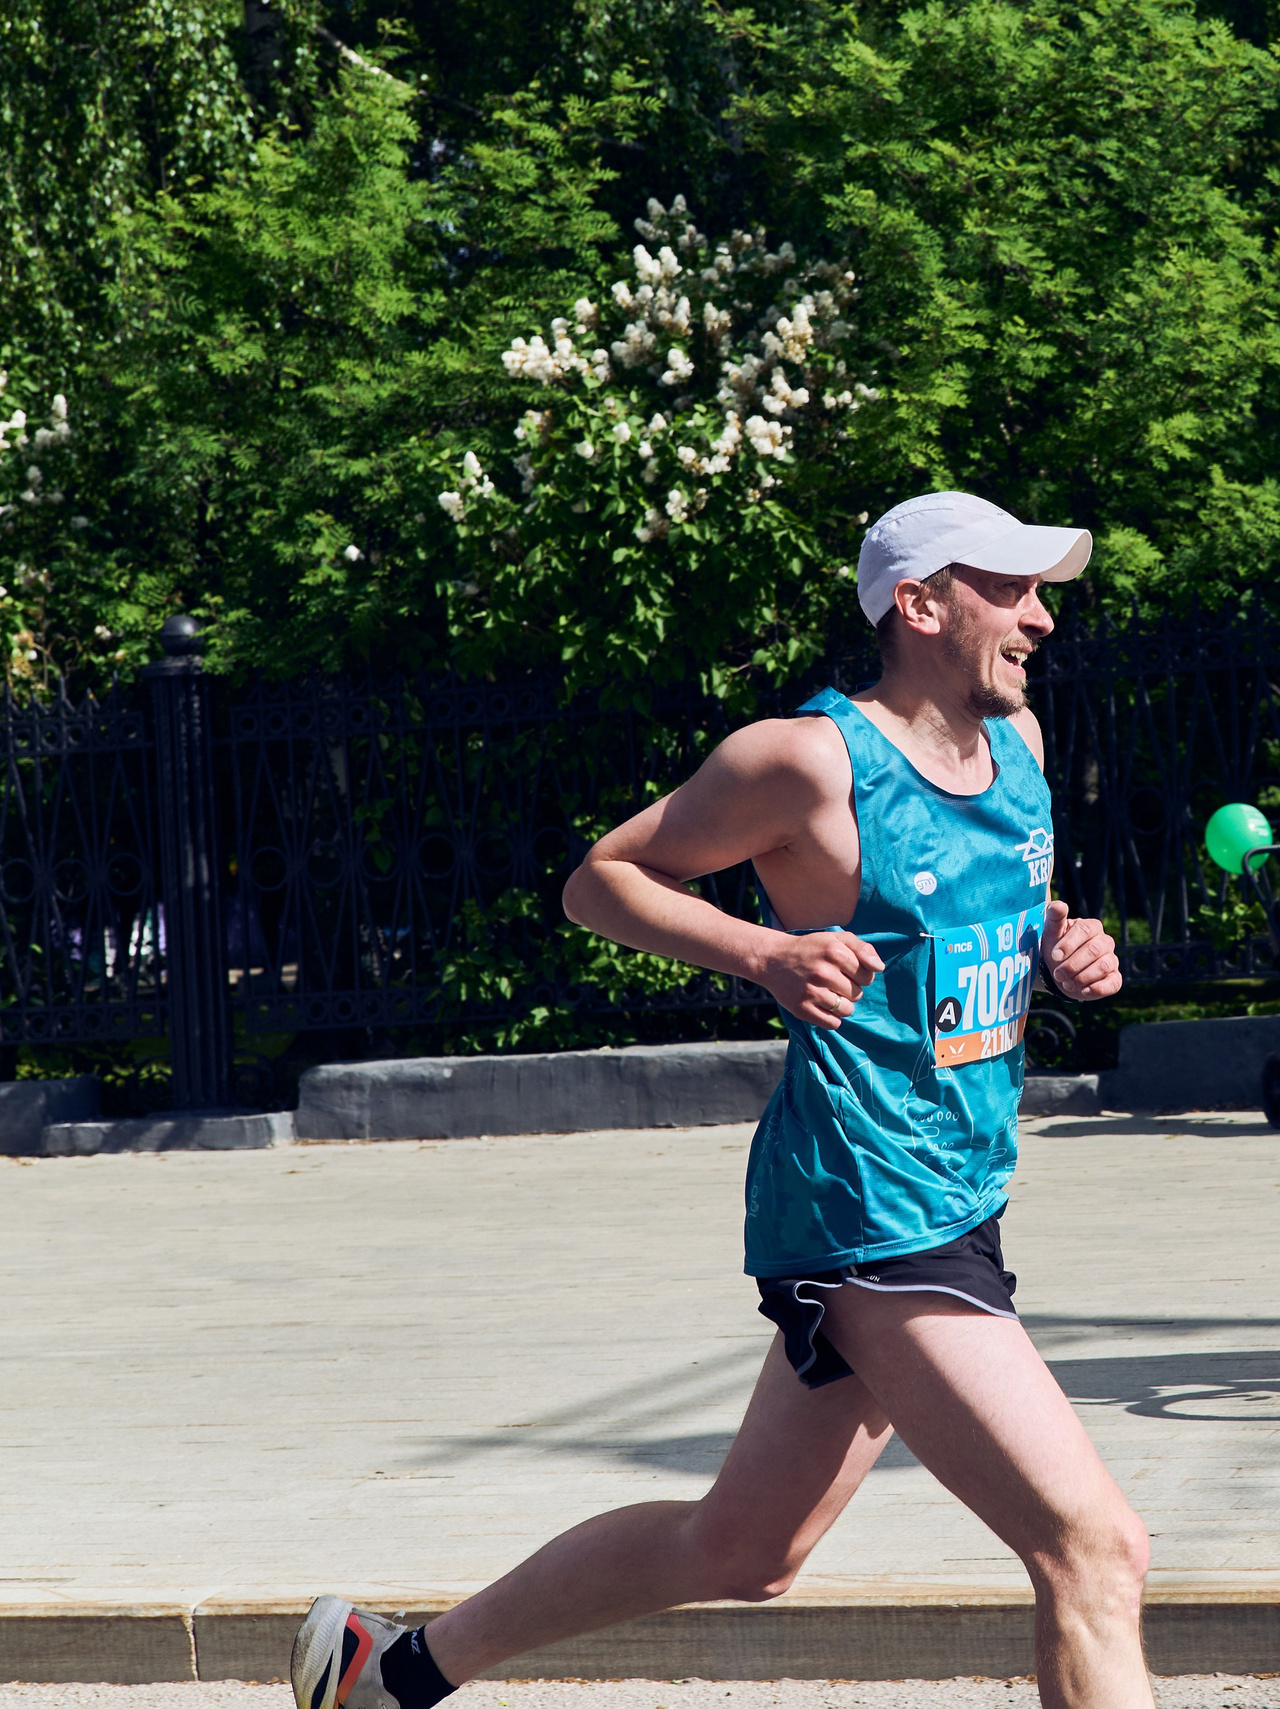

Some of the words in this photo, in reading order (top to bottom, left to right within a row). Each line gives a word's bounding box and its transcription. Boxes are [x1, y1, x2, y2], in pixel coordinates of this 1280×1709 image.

[954, 941, 973, 954] ПСБ
[996, 922, 1014, 953] 10
[958, 946, 1033, 1031] 70277
[938, 1001, 956, 1025] A
